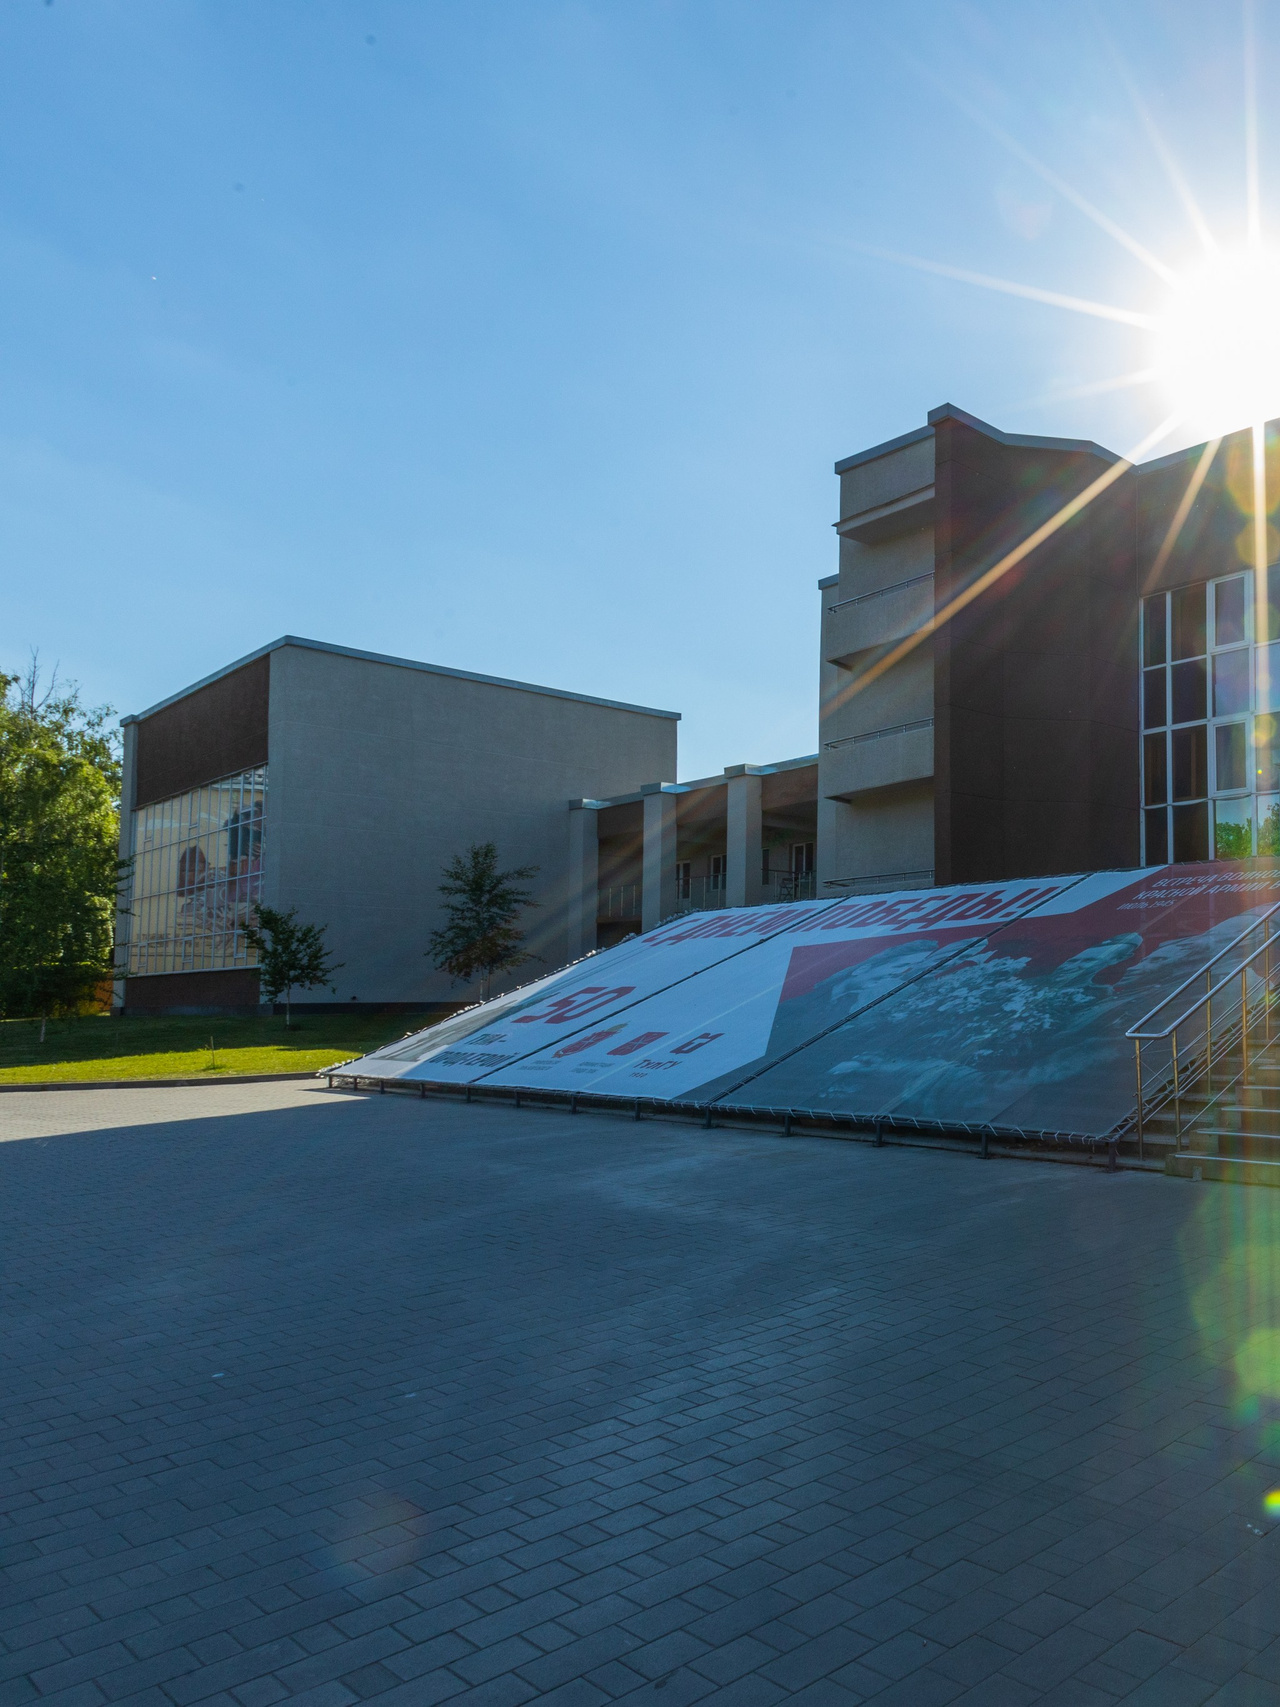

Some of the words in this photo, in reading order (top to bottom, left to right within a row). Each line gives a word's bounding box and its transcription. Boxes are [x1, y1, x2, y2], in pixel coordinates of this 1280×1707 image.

[1132, 884, 1207, 901] КРАСНОЙ
[1203, 881, 1270, 895] АРМИИ
[1151, 874, 1218, 888] ВСТРЕЧА
[650, 904, 818, 947] ДНЁМ
[511, 986, 637, 1025] 50
